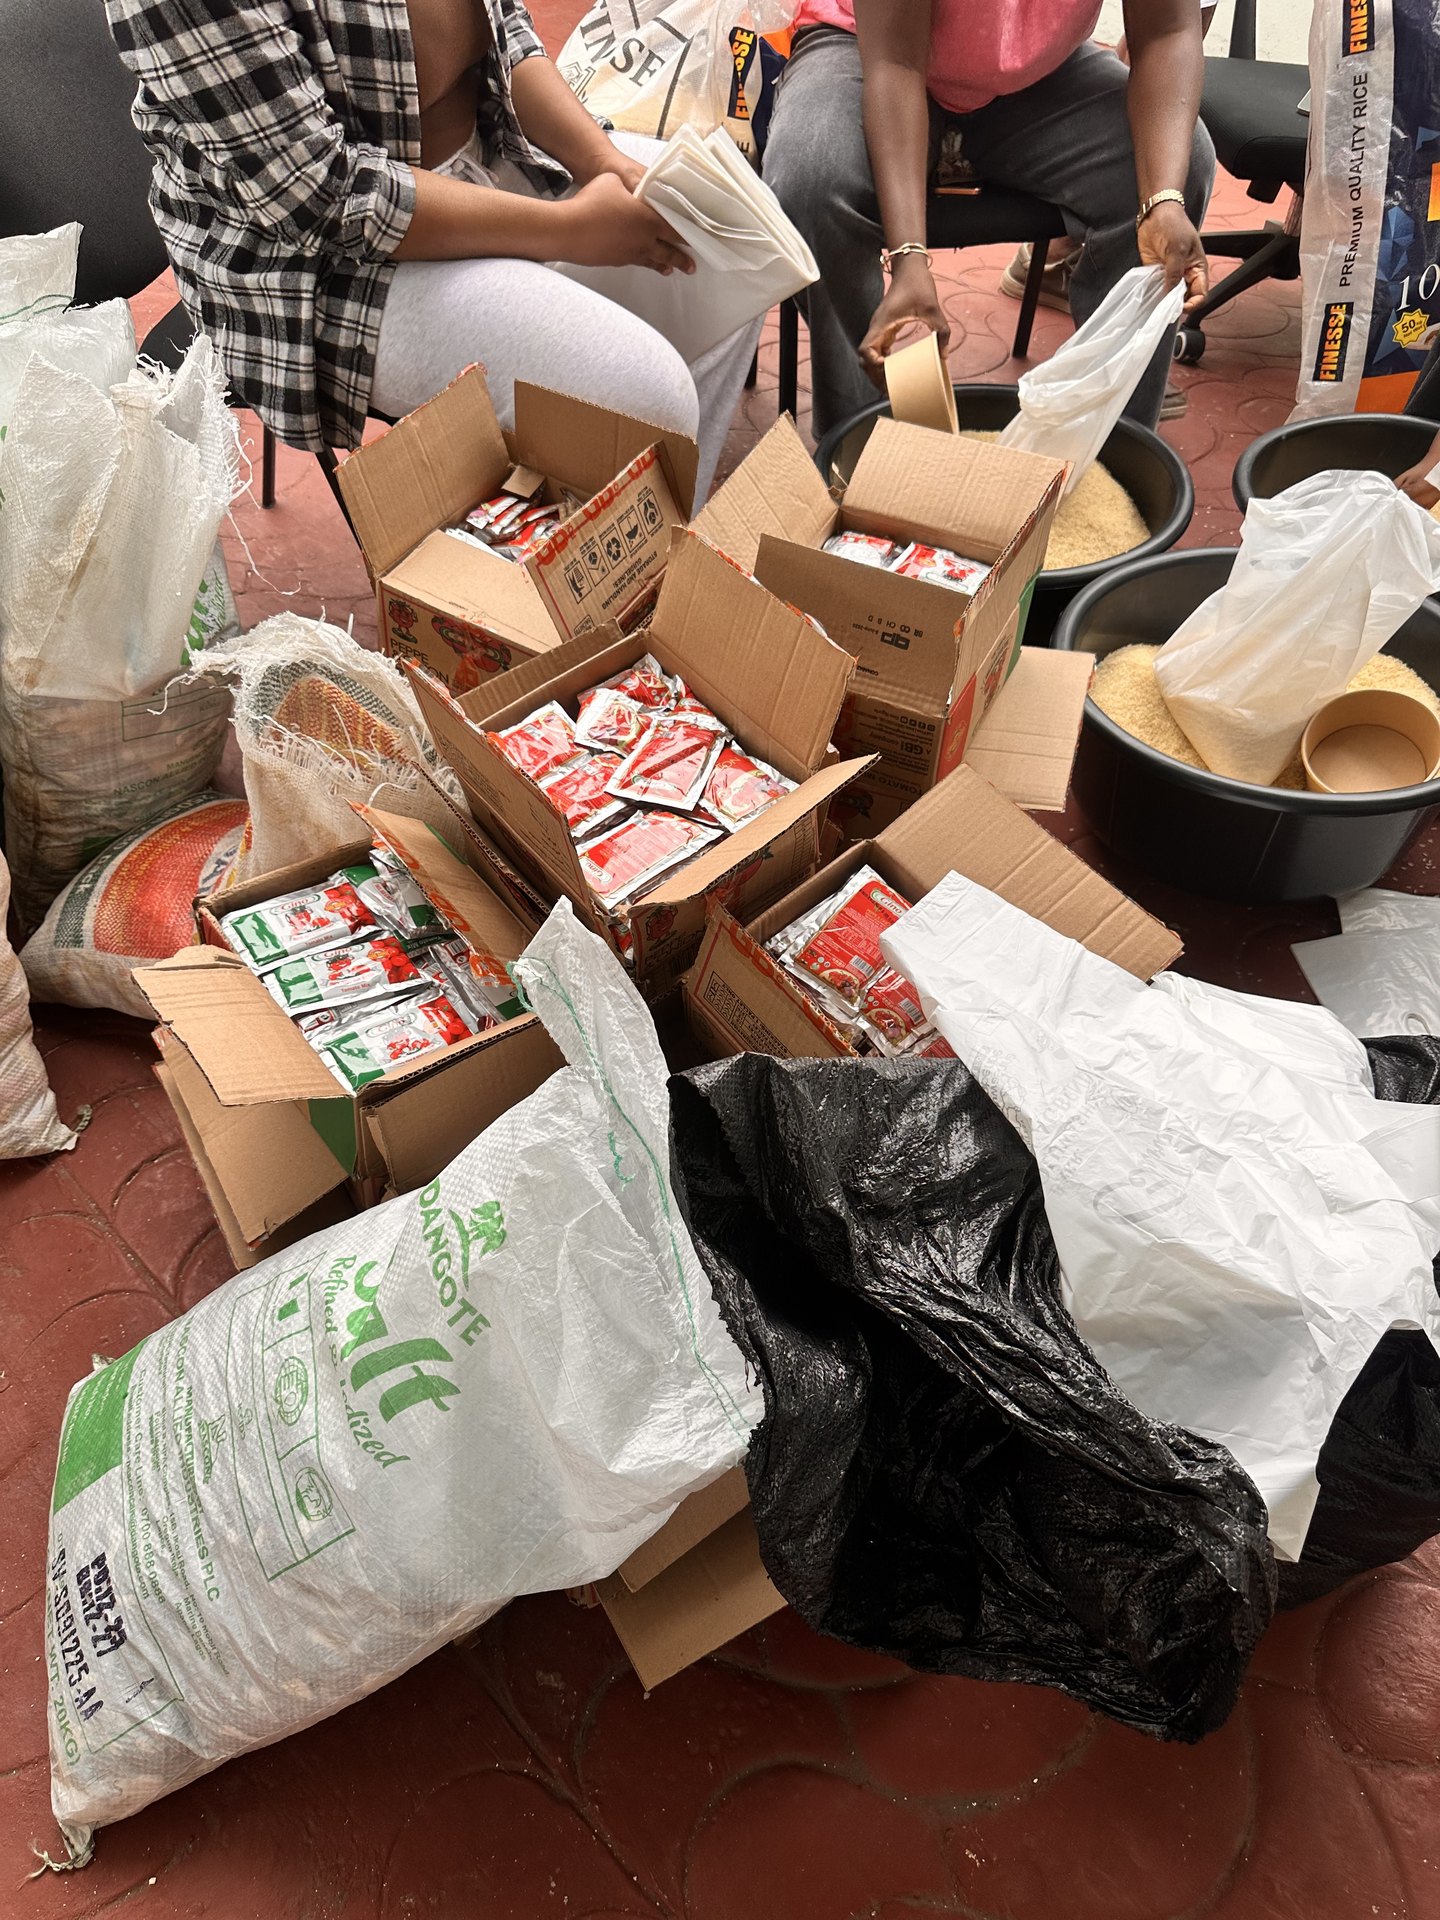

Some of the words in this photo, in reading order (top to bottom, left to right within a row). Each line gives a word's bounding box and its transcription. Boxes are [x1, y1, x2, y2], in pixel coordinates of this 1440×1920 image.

[1353, 73, 1368, 118] RICE
[1350, 120, 1366, 201] QUALITY
[1340, 206, 1364, 287] PREMIUM
[1319, 303, 1347, 380] FINESSE
[1402, 320, 1415, 333] 50
[634, 550, 658, 574] STORAGE
[601, 582, 626, 610] HANDLING
[881, 897, 902, 914] Gino
[324, 947, 353, 958] Gino
[418, 1178, 491, 1346] DANGOTE
[323, 1254, 357, 1334] Refined
[135, 1369, 146, 1429] Customer
[135, 1432, 143, 1464] Care
[135, 1466, 145, 1499] Line:
[141, 1507, 149, 1540] 0700
[144, 1543, 155, 1568] 888
[199, 1562, 222, 1603] PLC
[54, 1695, 82, 1767] 20KG)
